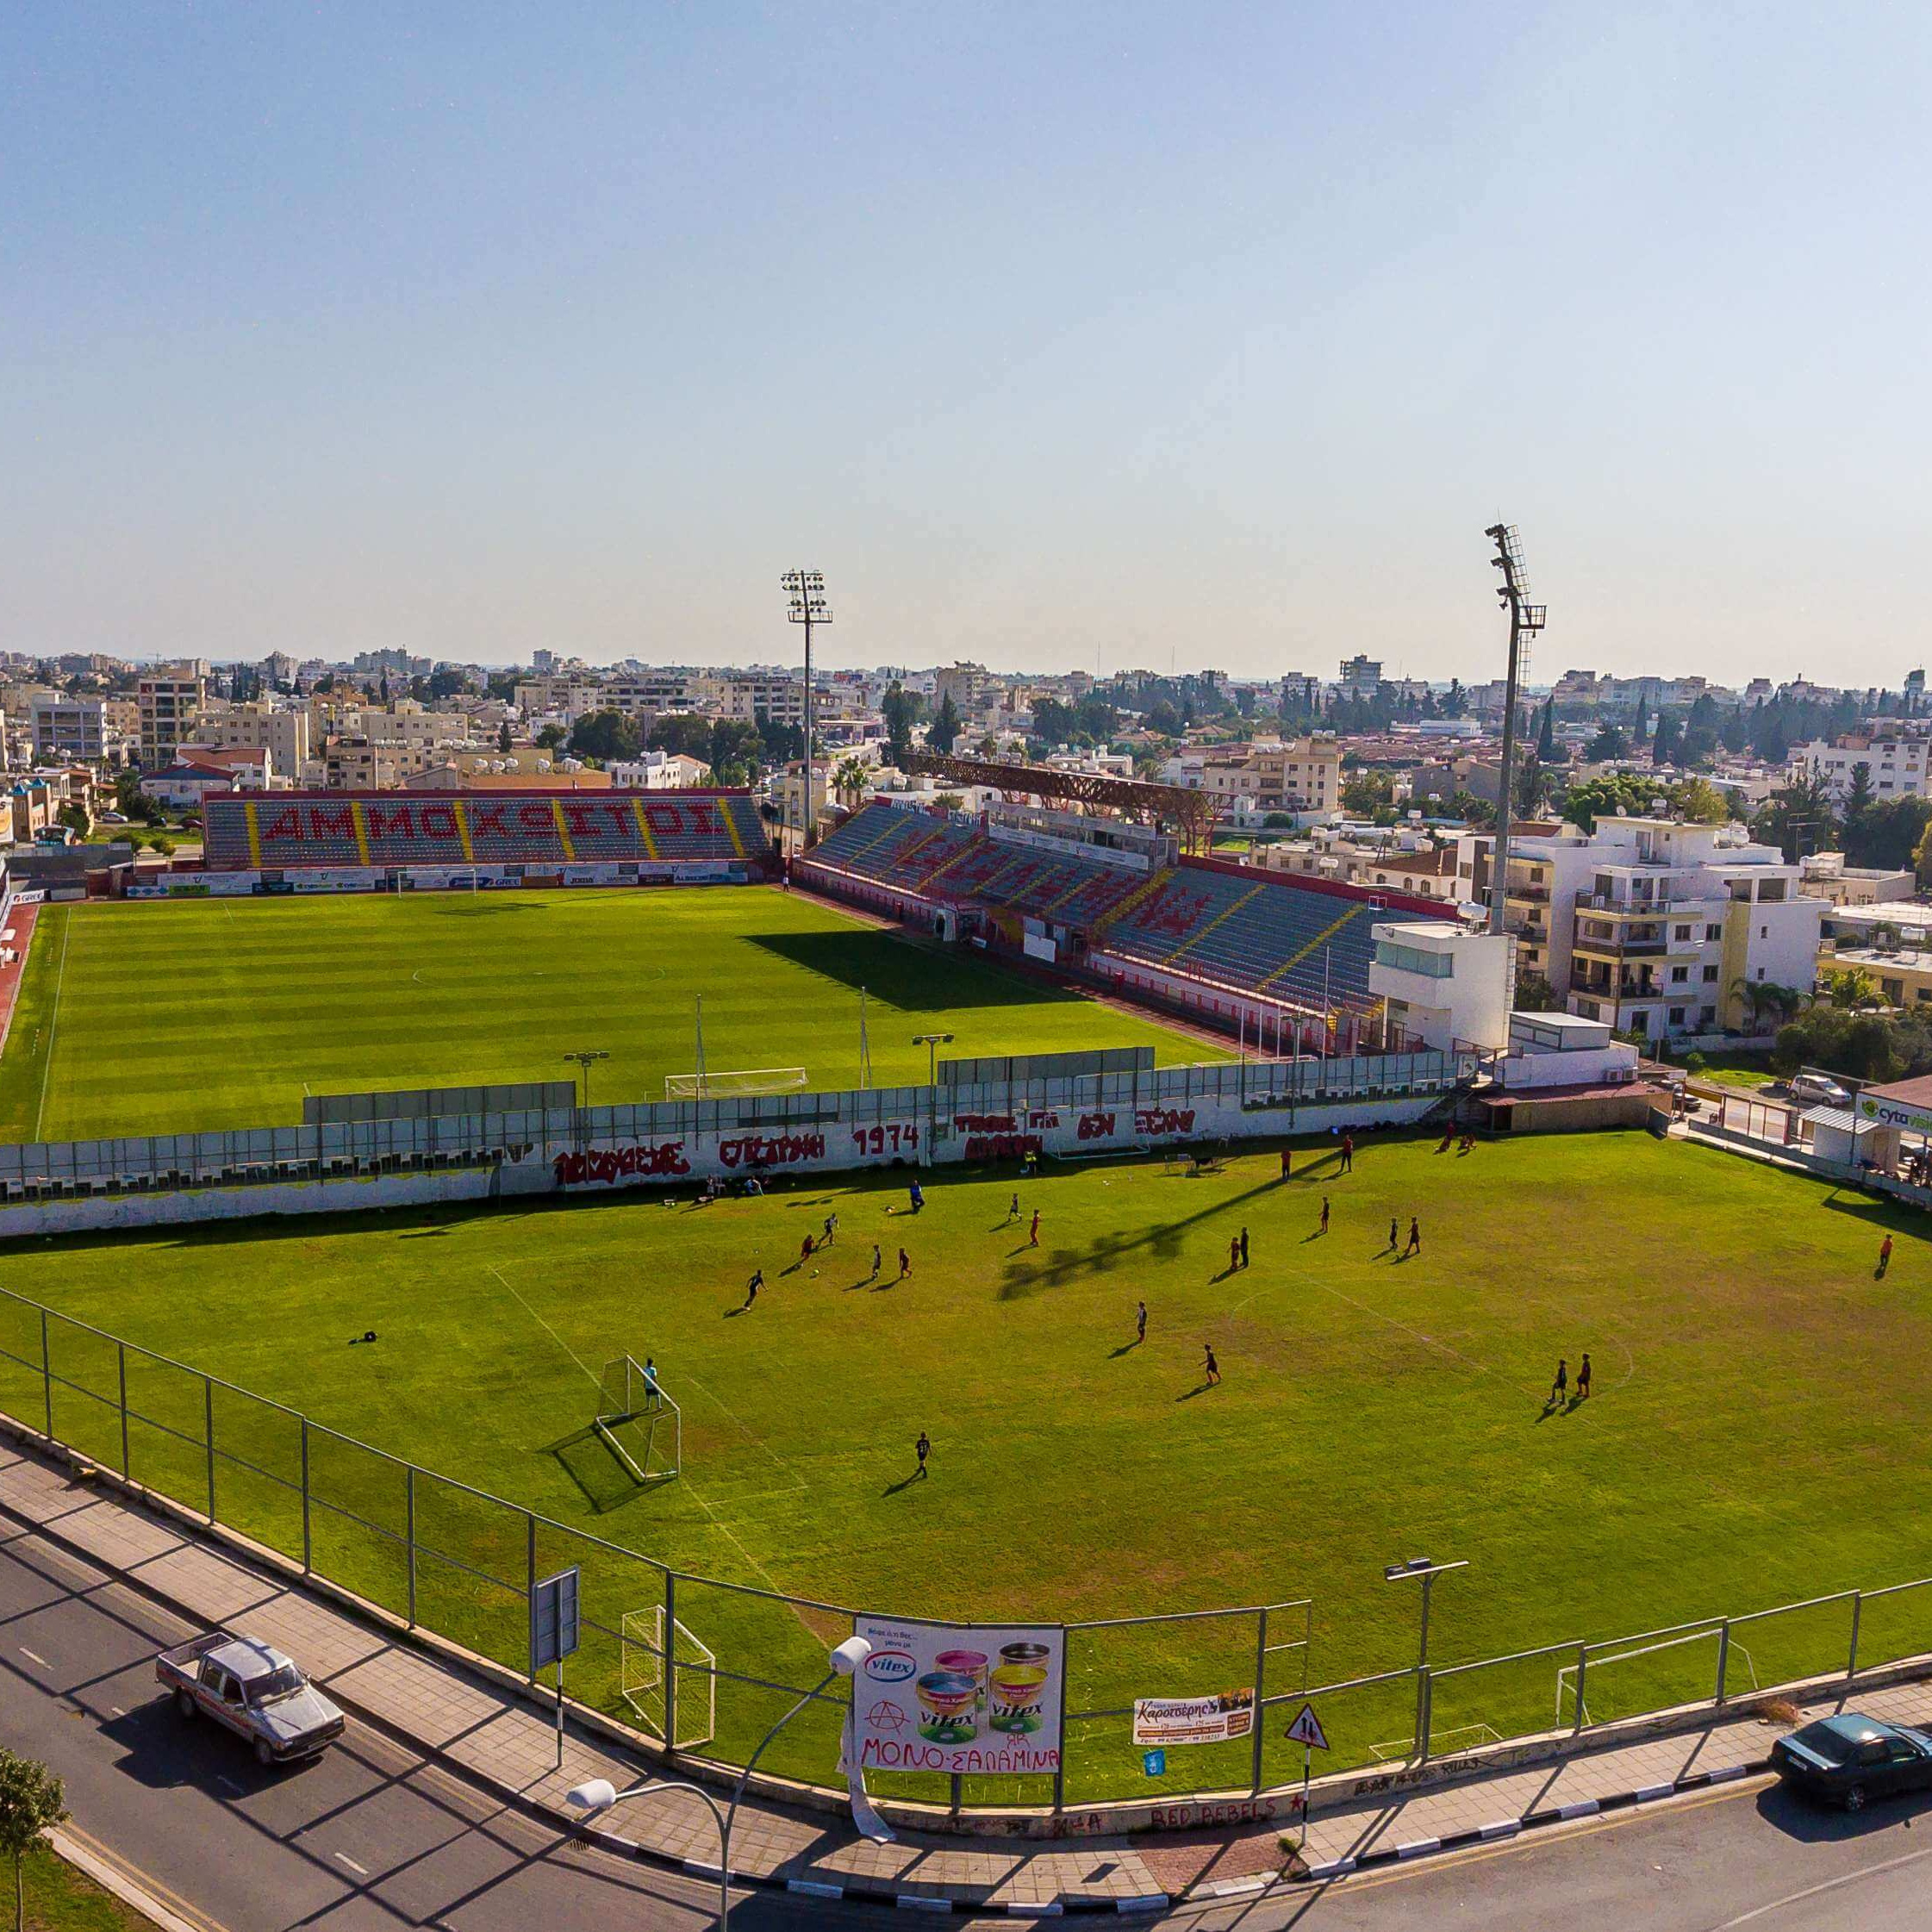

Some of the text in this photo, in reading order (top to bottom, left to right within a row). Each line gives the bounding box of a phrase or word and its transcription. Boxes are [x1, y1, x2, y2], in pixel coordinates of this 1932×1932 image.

[852, 1124, 919, 1156] 1974
[871, 1657, 911, 1673] vitex
[992, 1701, 1044, 1718] vitex
[920, 1711, 975, 1728] vitex
[1150, 1797, 1276, 1827] RED REBELS
